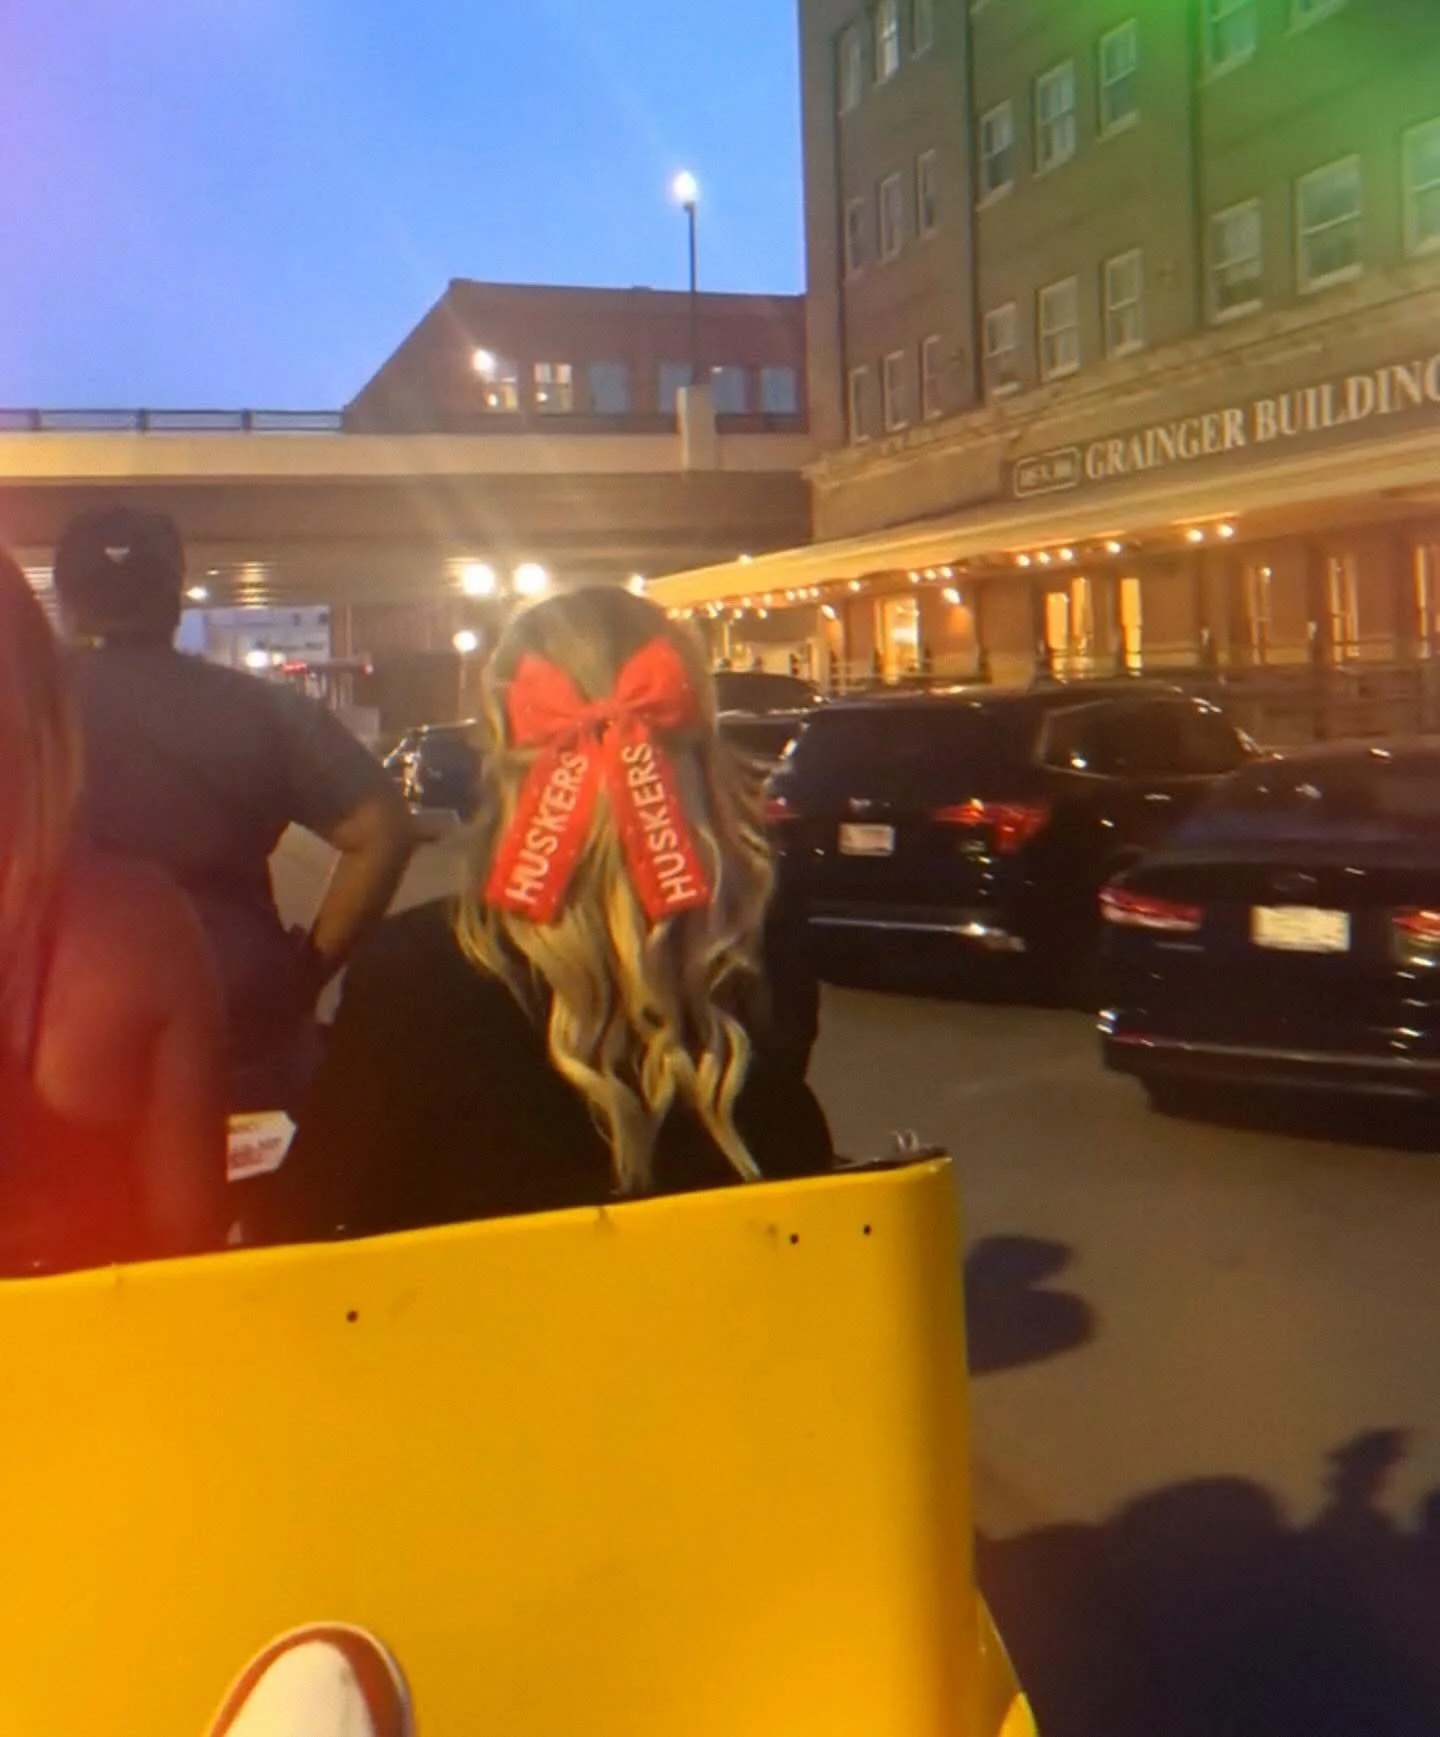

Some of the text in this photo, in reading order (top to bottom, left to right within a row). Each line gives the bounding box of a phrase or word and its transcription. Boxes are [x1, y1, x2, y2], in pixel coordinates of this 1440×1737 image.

[1085, 408, 1246, 479] GRAINGER
[505, 752, 588, 905] HUSKERS
[621, 743, 698, 903] HUSKERS
